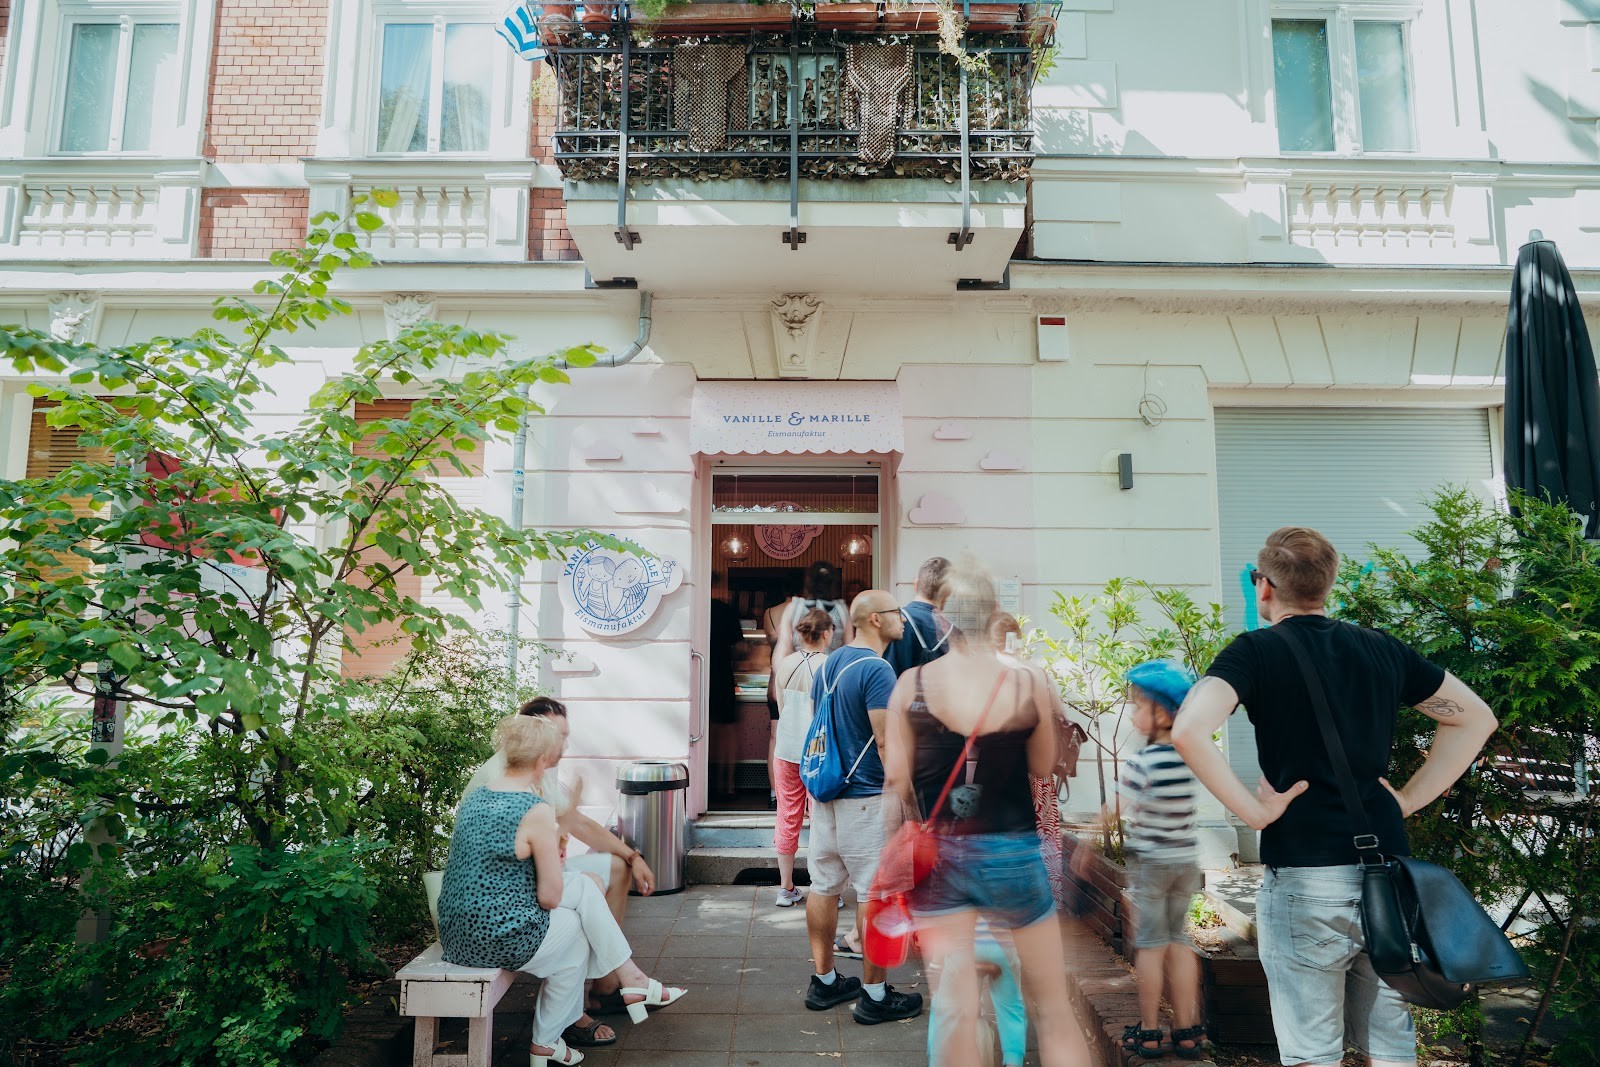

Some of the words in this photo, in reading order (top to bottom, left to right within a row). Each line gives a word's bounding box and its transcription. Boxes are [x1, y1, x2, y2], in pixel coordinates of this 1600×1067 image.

[723, 415, 782, 423] VANILLE
[788, 411, 805, 426] &
[809, 414, 871, 423] MARILLE
[767, 430, 826, 438] Eismanufaktur
[574, 608, 647, 632] Eismanufaktur
